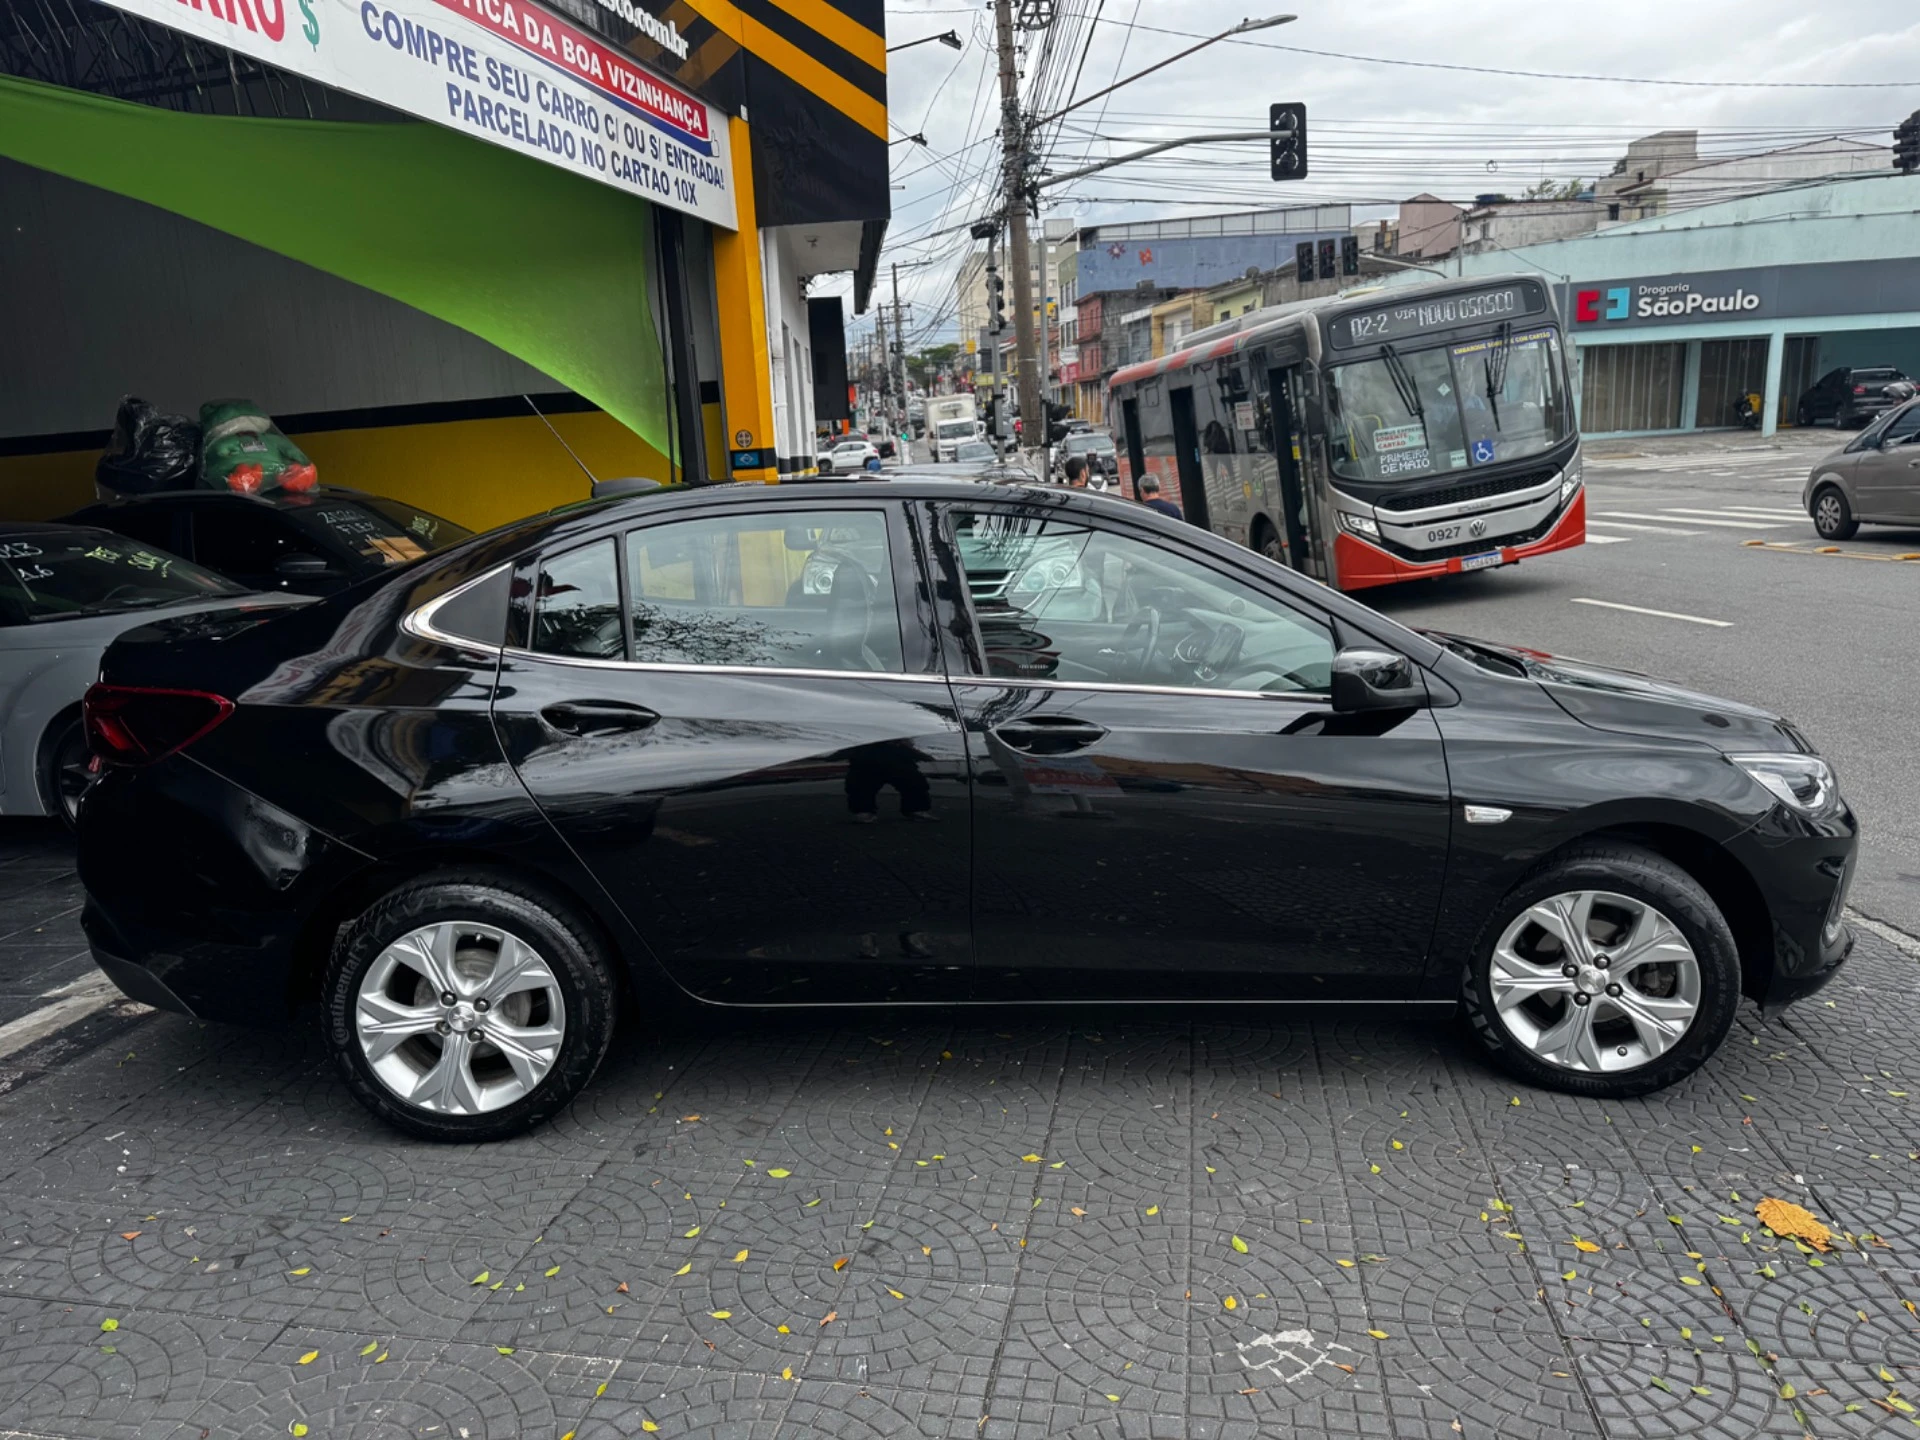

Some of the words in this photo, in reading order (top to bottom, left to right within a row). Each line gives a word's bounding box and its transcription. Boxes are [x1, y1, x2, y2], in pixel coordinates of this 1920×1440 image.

[523, 12, 557, 56] DA
[561, 35, 603, 80] BOA
[606, 61, 704, 134] VIZINHANÇA
[361, 1, 479, 84] COMPRE
[487, 59, 530, 104] SEU
[537, 81, 600, 135] CARRO
[625, 121, 646, 155] OU
[666, 146, 726, 191] ENTRADA!
[447, 82, 577, 160] PARCELADO
[582, 139, 606, 172] NO
[674, 176, 699, 207] 10X
[1638, 284, 1690, 296] Drogaria
[1638, 289, 1760, 318] SãoPaulo
[1395, 309, 1417, 320] VIA
[1419, 302, 1457, 327] NOVO
[1459, 291, 1514, 319] OSASCO
[1380, 449, 1429, 464] PRIMEIRO
[1381, 464, 1398, 474] DE
[1399, 460, 1430, 472] MAIO
[1428, 526, 1461, 542] 0927
